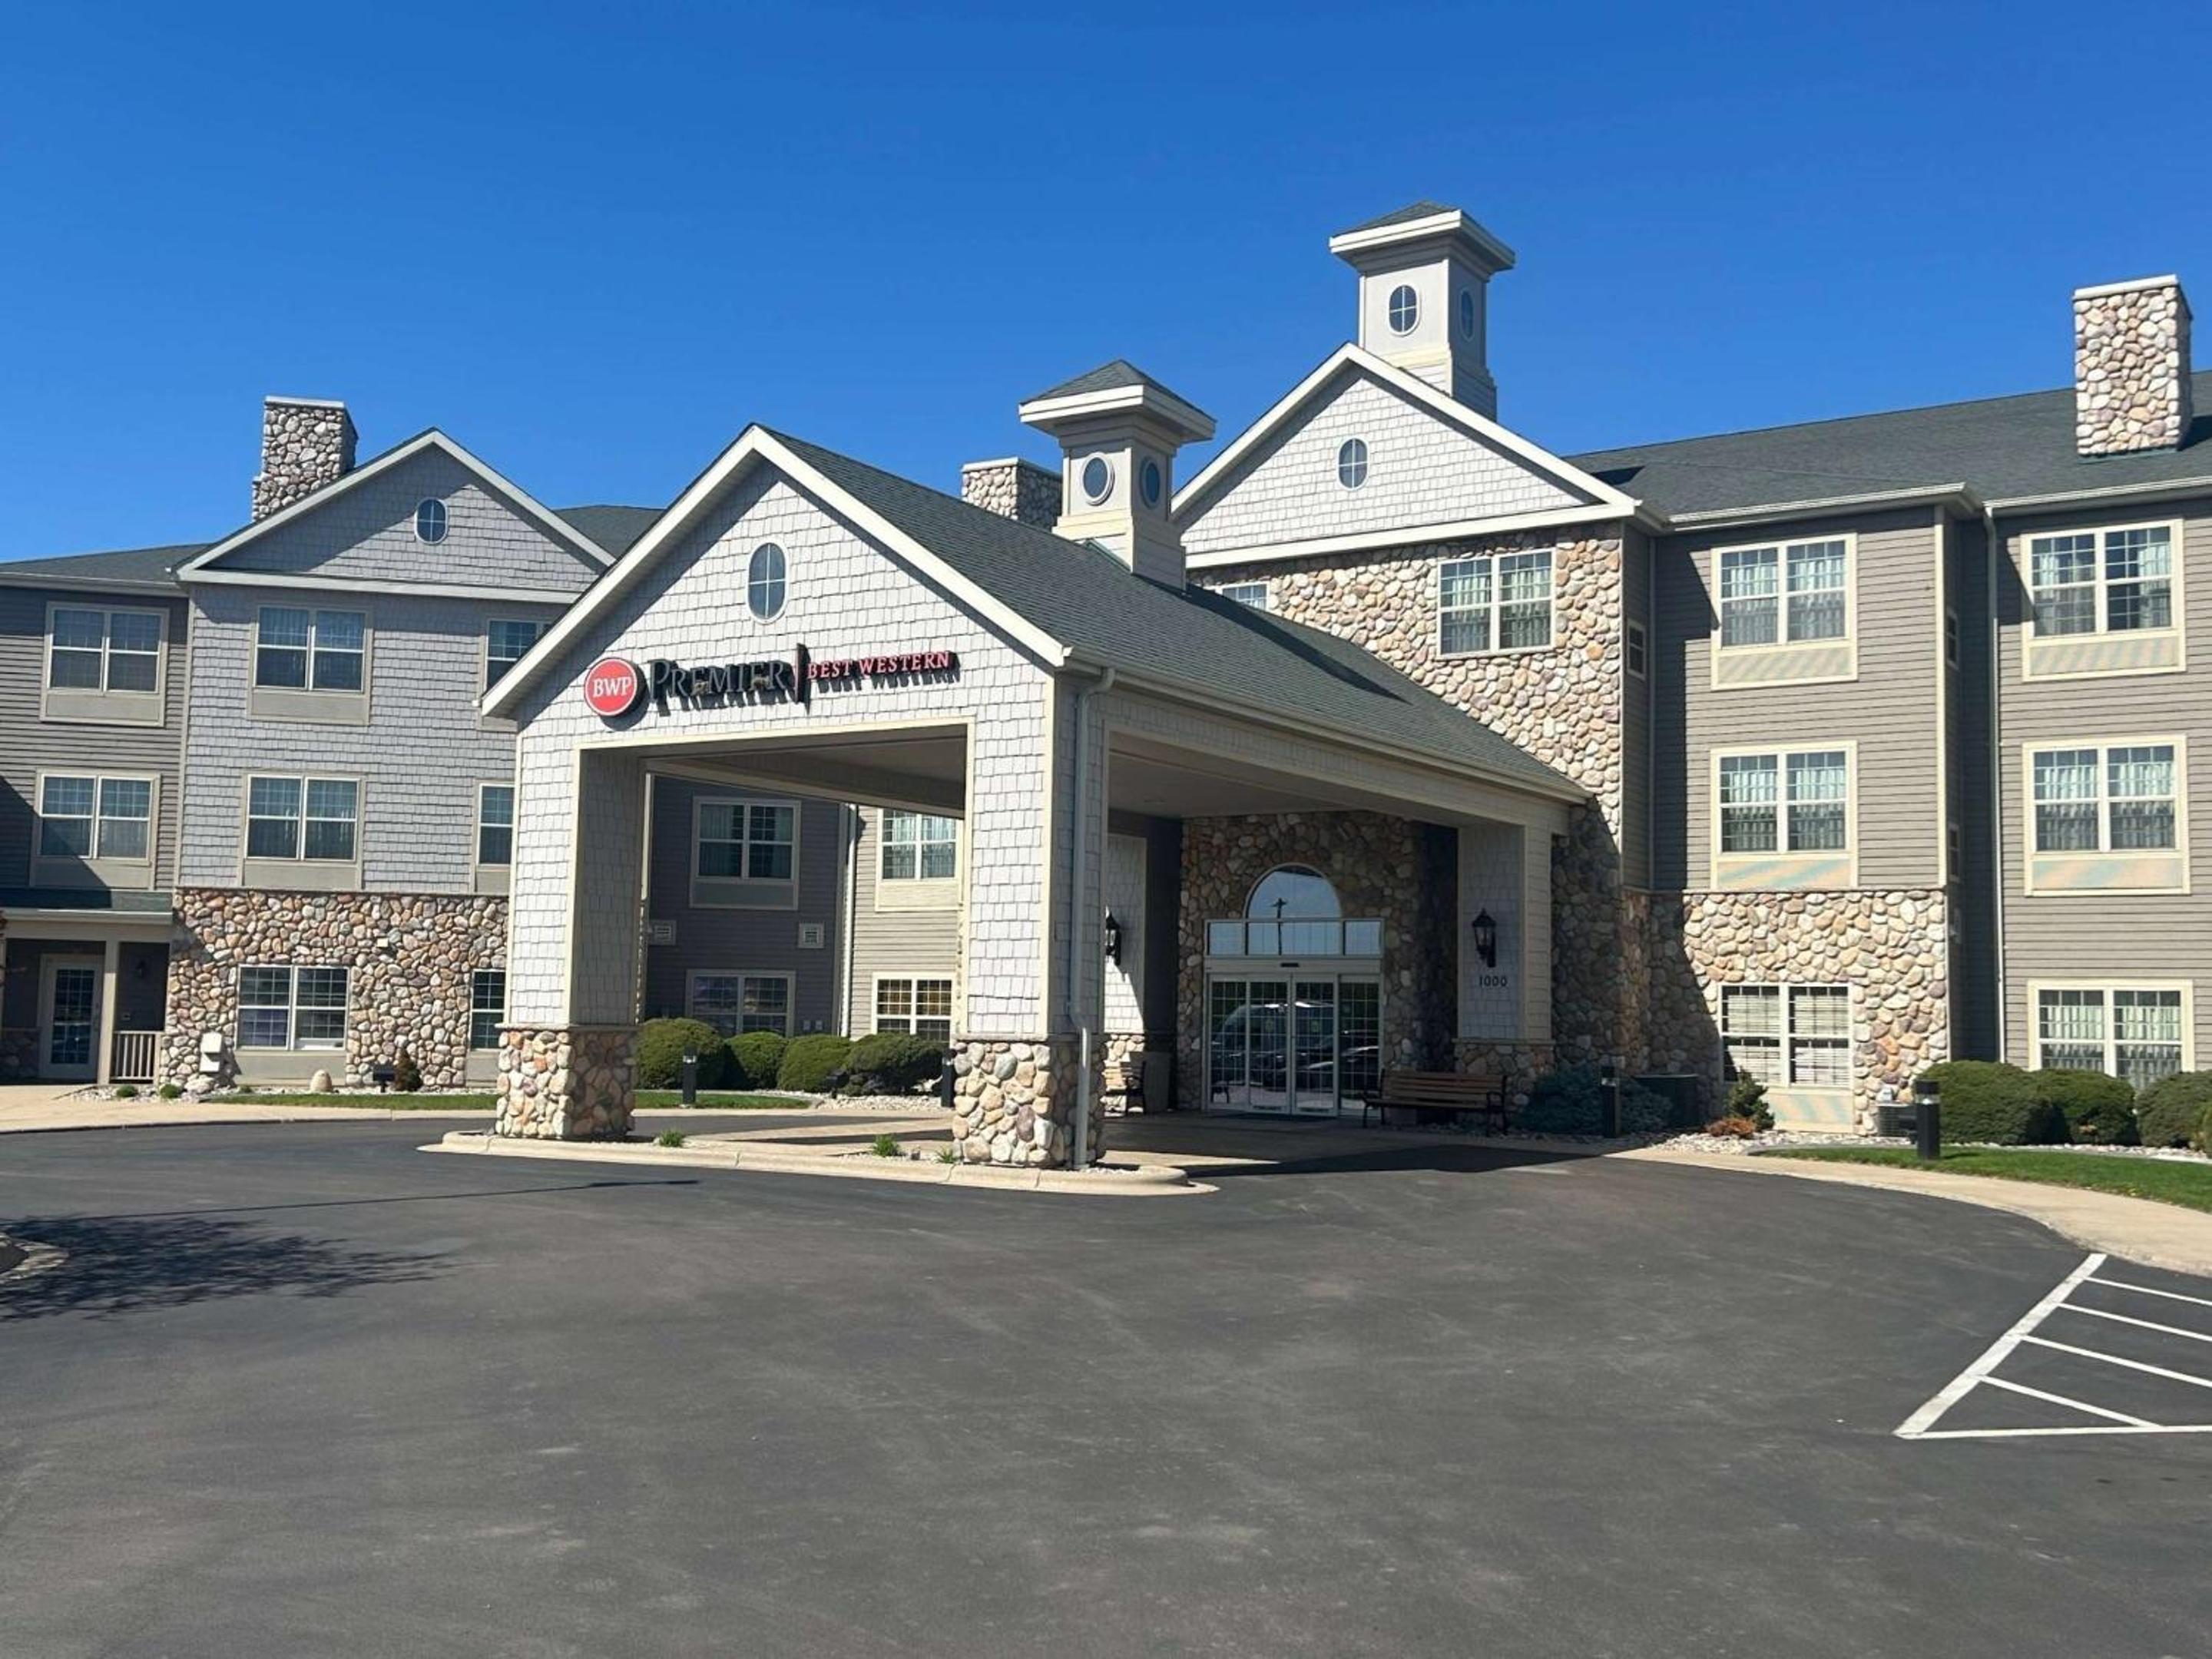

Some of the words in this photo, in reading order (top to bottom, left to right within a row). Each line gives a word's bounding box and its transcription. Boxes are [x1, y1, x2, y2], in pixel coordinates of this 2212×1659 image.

[807, 659, 853, 679] BEST
[859, 651, 950, 675] WESTERN
[593, 676, 632, 698] BWP
[649, 660, 786, 702] PREMIER
[1479, 975, 1508, 988] 1000
